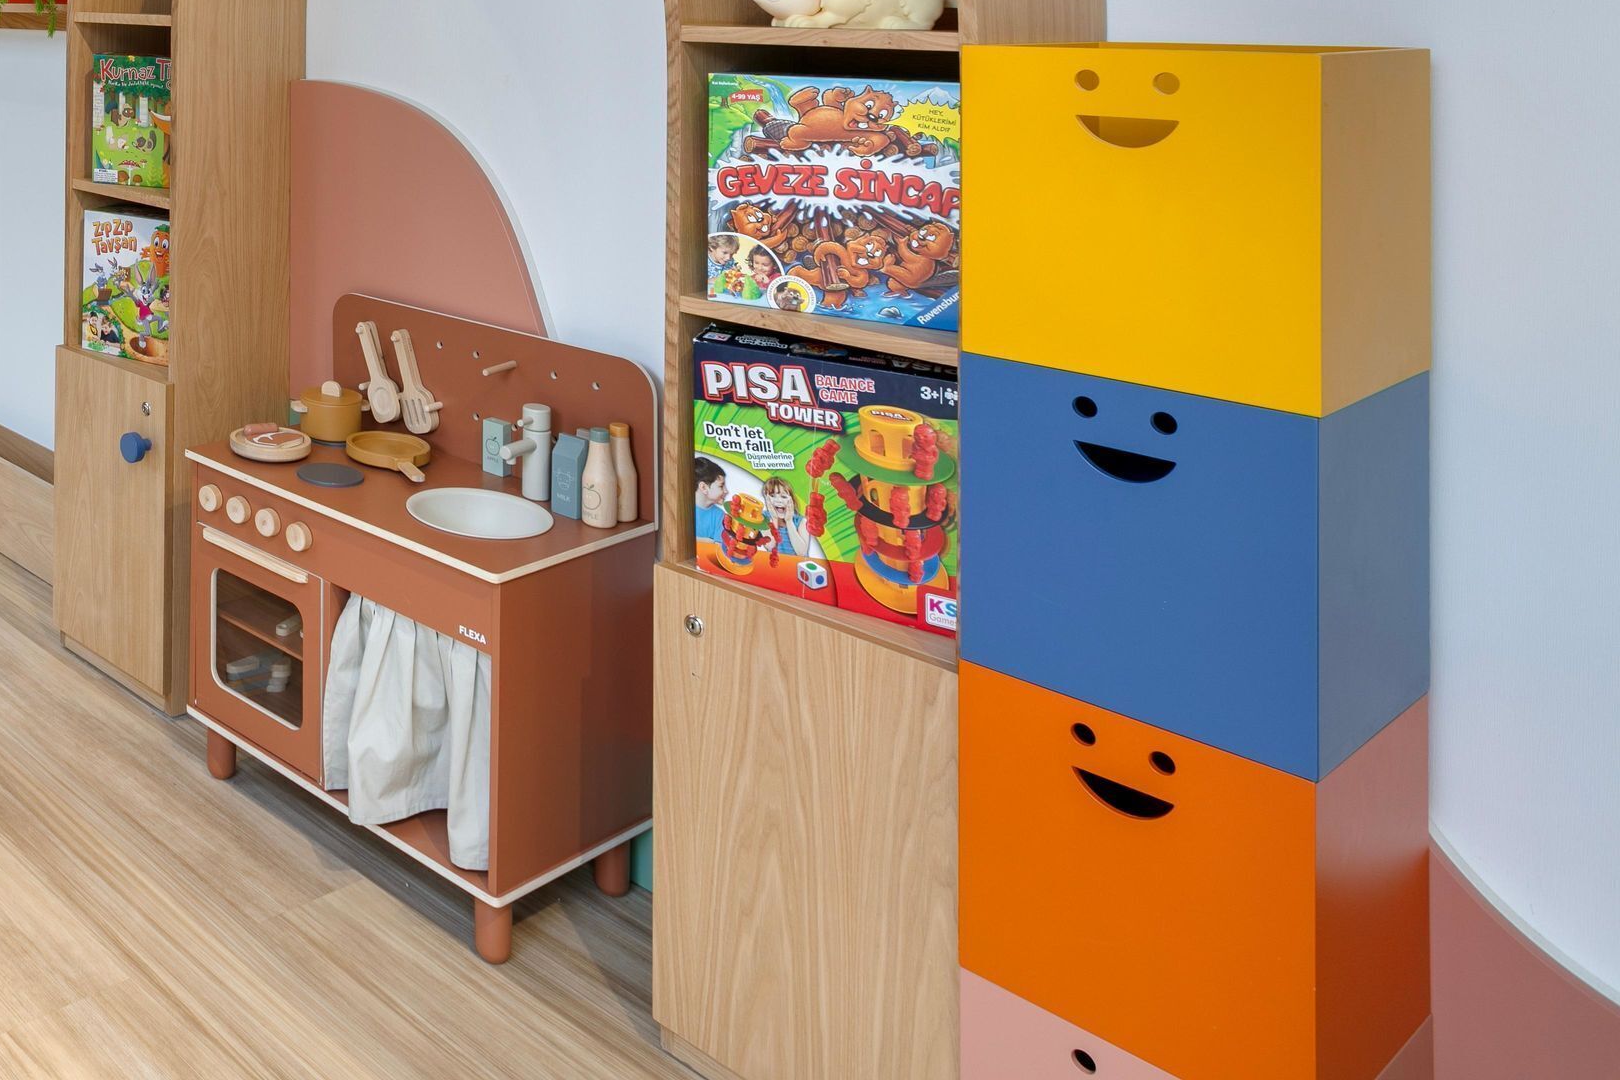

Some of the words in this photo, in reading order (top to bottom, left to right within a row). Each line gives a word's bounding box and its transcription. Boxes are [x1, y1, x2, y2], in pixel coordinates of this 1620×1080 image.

[100, 58, 156, 81] Kurnaz
[717, 164, 829, 198] GEVEZE
[833, 159, 960, 218] SİNCAP
[91, 237, 138, 255] Tavşan
[703, 362, 812, 403] PISA
[814, 374, 875, 394] BALANCE
[819, 388, 859, 405] GAME
[920, 386, 939, 400] 3+
[766, 401, 842, 428] TOWER
[705, 423, 741, 437] Don't
[744, 427, 763, 439] let
[745, 440, 772, 452] fall!
[747, 453, 793, 461] Düşmelerine
[930, 598, 957, 618] KS
[459, 624, 487, 645] FLEXA
